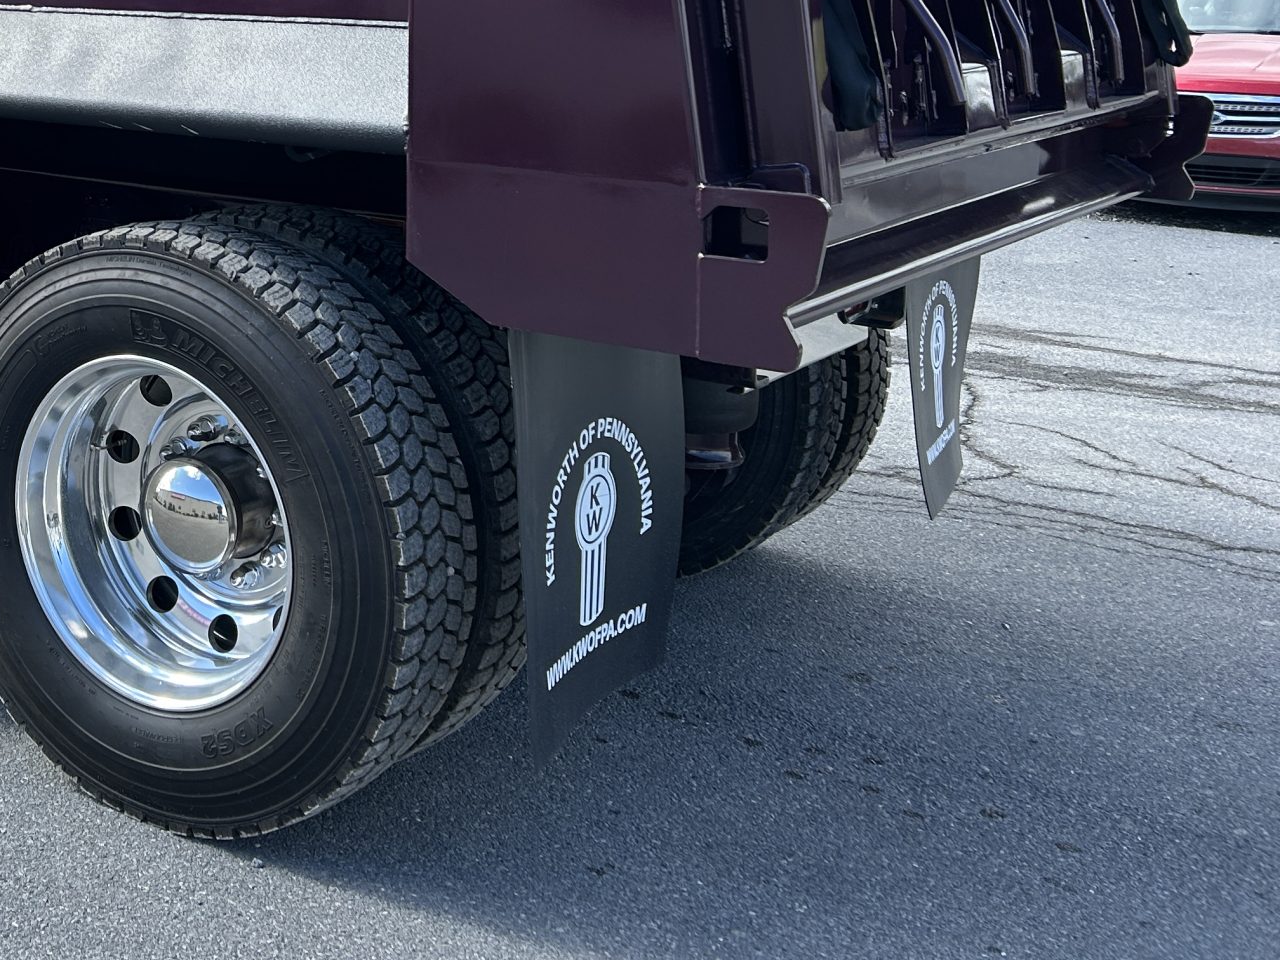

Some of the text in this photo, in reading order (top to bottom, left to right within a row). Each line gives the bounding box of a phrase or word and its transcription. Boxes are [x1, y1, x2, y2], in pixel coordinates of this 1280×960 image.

[171, 328, 309, 484] MICHELIN
[545, 417, 653, 587] KENWORTH OF PENNSYLVANIA
[546, 602, 647, 691] WWW.KWOFPA.COM
[200, 706, 274, 758] XDS2
